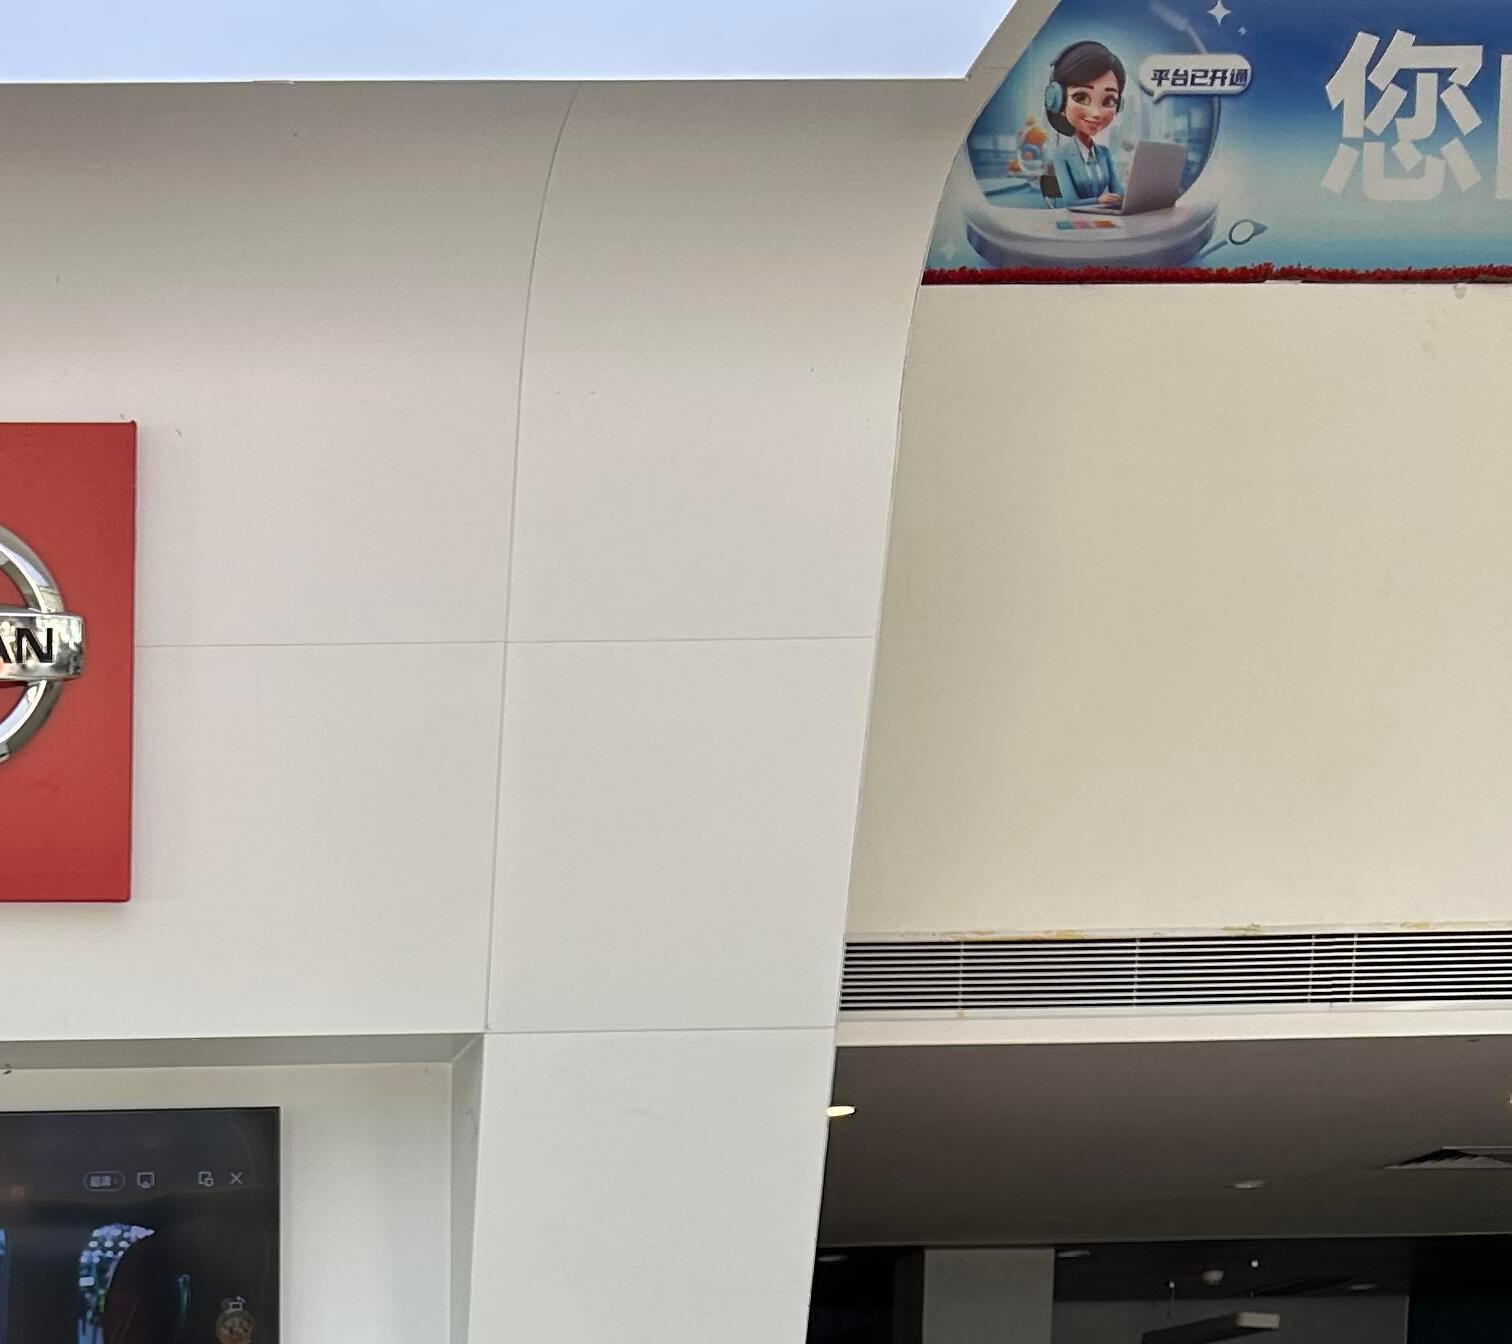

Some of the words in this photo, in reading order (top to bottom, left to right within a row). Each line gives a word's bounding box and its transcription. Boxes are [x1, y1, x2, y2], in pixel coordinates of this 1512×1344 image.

[1151, 68, 1249, 87] 平台已开通
[1322, 30, 1512, 201] 您
